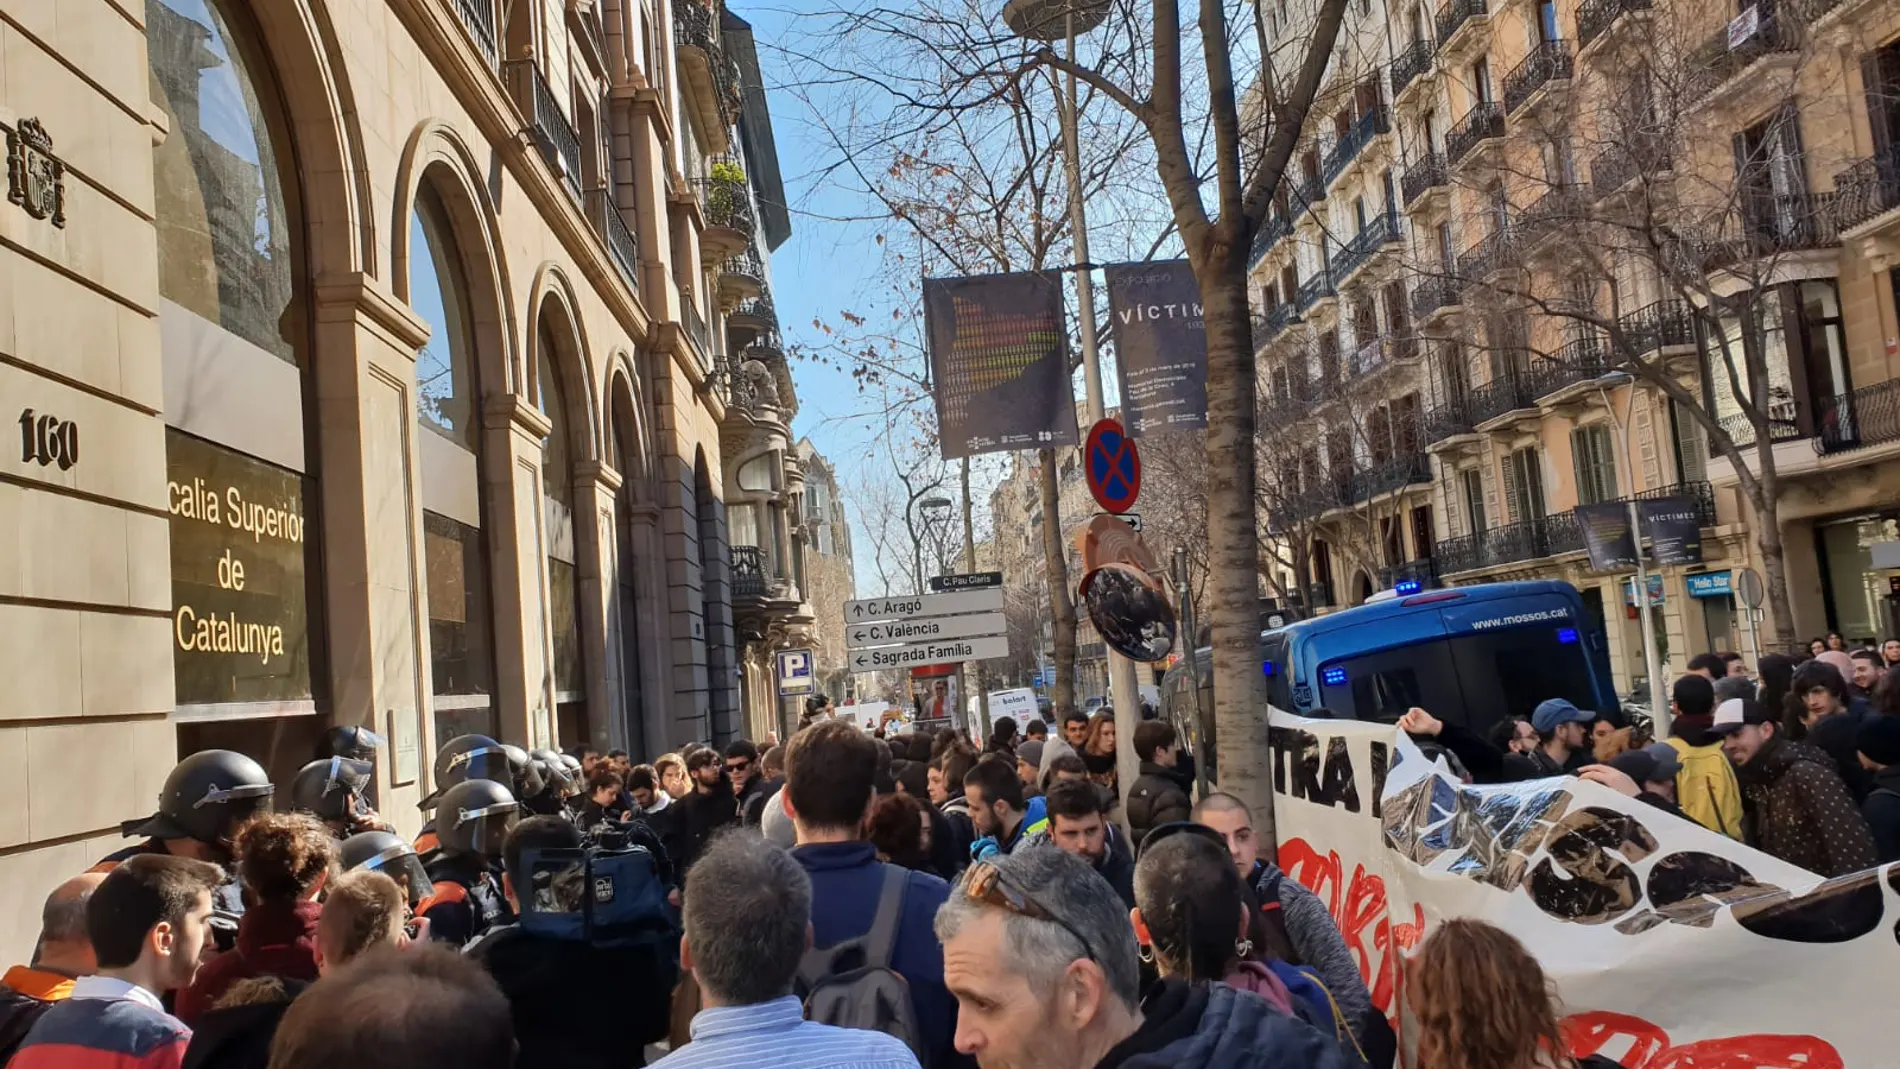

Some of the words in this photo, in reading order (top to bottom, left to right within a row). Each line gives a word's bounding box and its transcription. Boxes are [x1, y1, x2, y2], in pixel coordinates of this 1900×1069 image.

[18, 408, 78, 471] 160
[167, 477, 221, 525] calia
[218, 549, 244, 591] de
[943, 577, 951, 587] C.
[952, 576, 967, 586] Pau
[968, 574, 991, 585] Claris
[868, 602, 882, 615] C.
[884, 598, 922, 616] Aragó
[1471, 606, 1568, 631] www.mossos.cat
[176, 605, 284, 665] Catalunya
[870, 627, 883, 640] C.
[886, 621, 940, 638] València
[785, 655, 804, 677] P
[872, 648, 925, 667] Sagrada
[928, 643, 972, 660] Família
